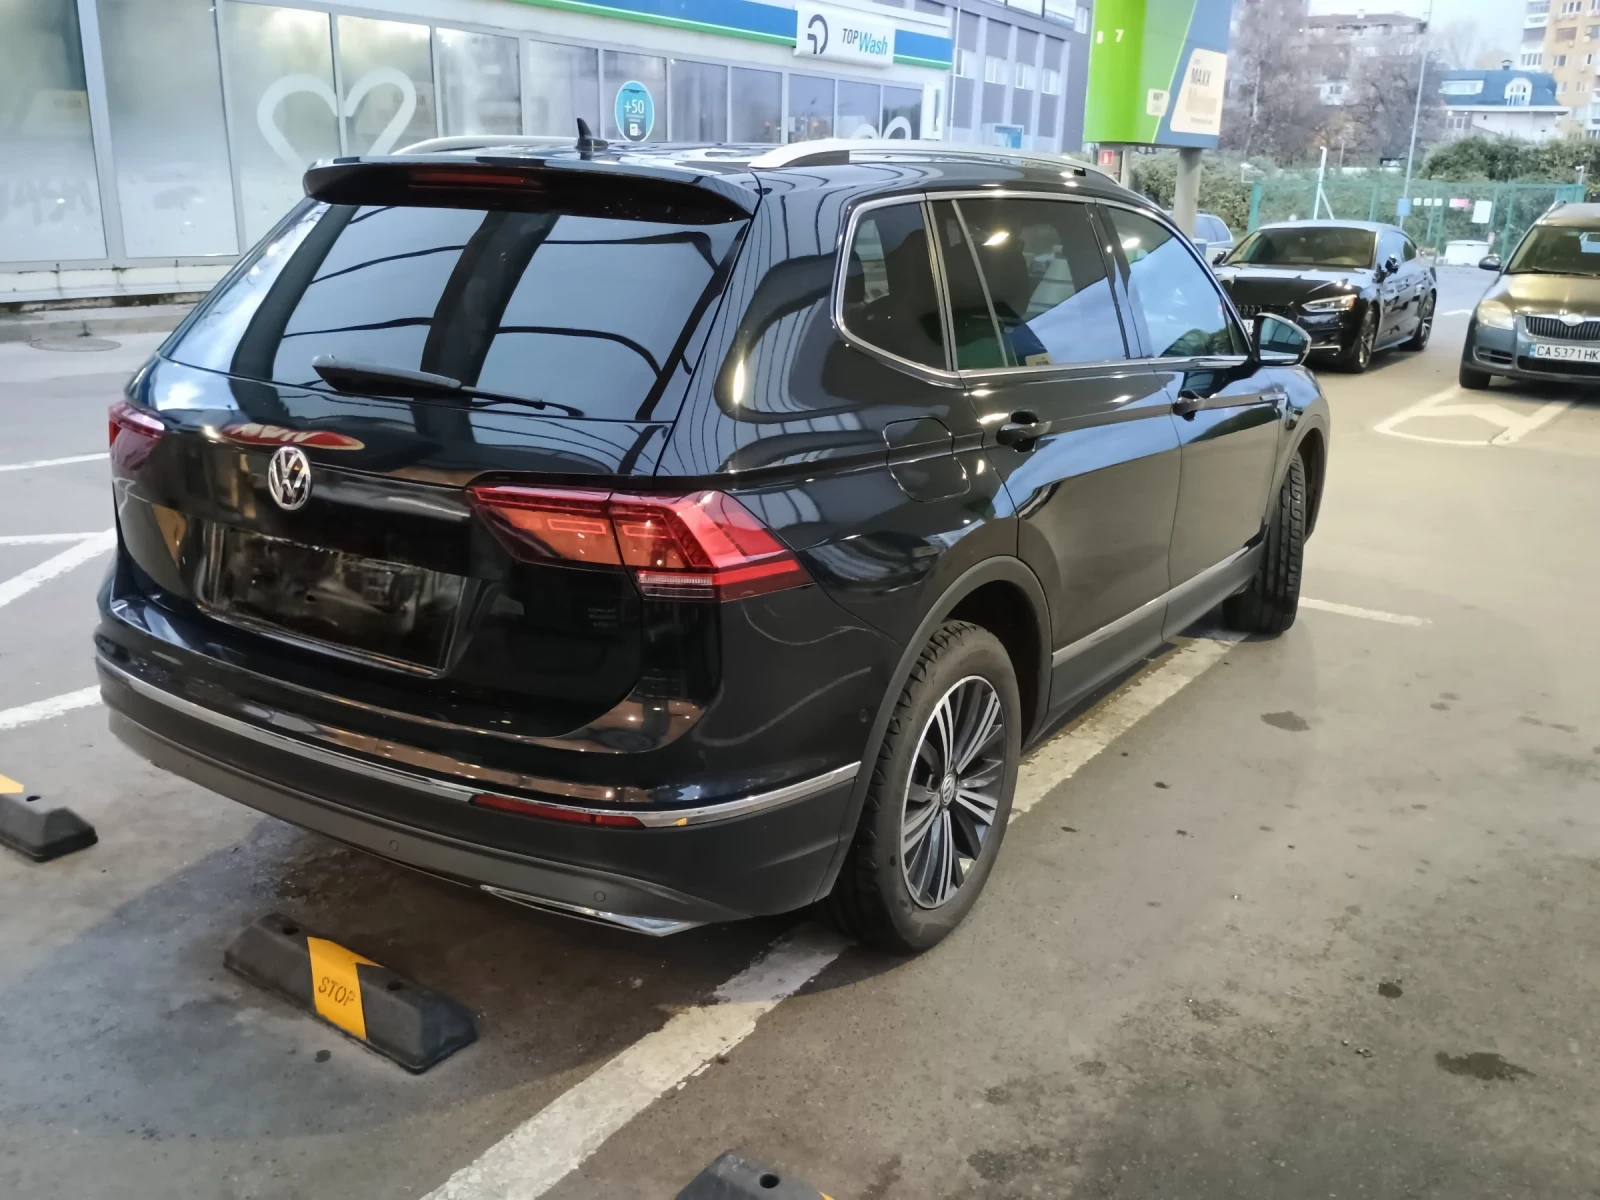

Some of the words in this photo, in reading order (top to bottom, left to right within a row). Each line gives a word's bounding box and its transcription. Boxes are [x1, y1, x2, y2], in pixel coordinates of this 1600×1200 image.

[843, 28, 859, 44] TOP
[859, 31, 888, 56] Wash
[624, 99, 645, 114] +50
[318, 976, 356, 1007] STOP
